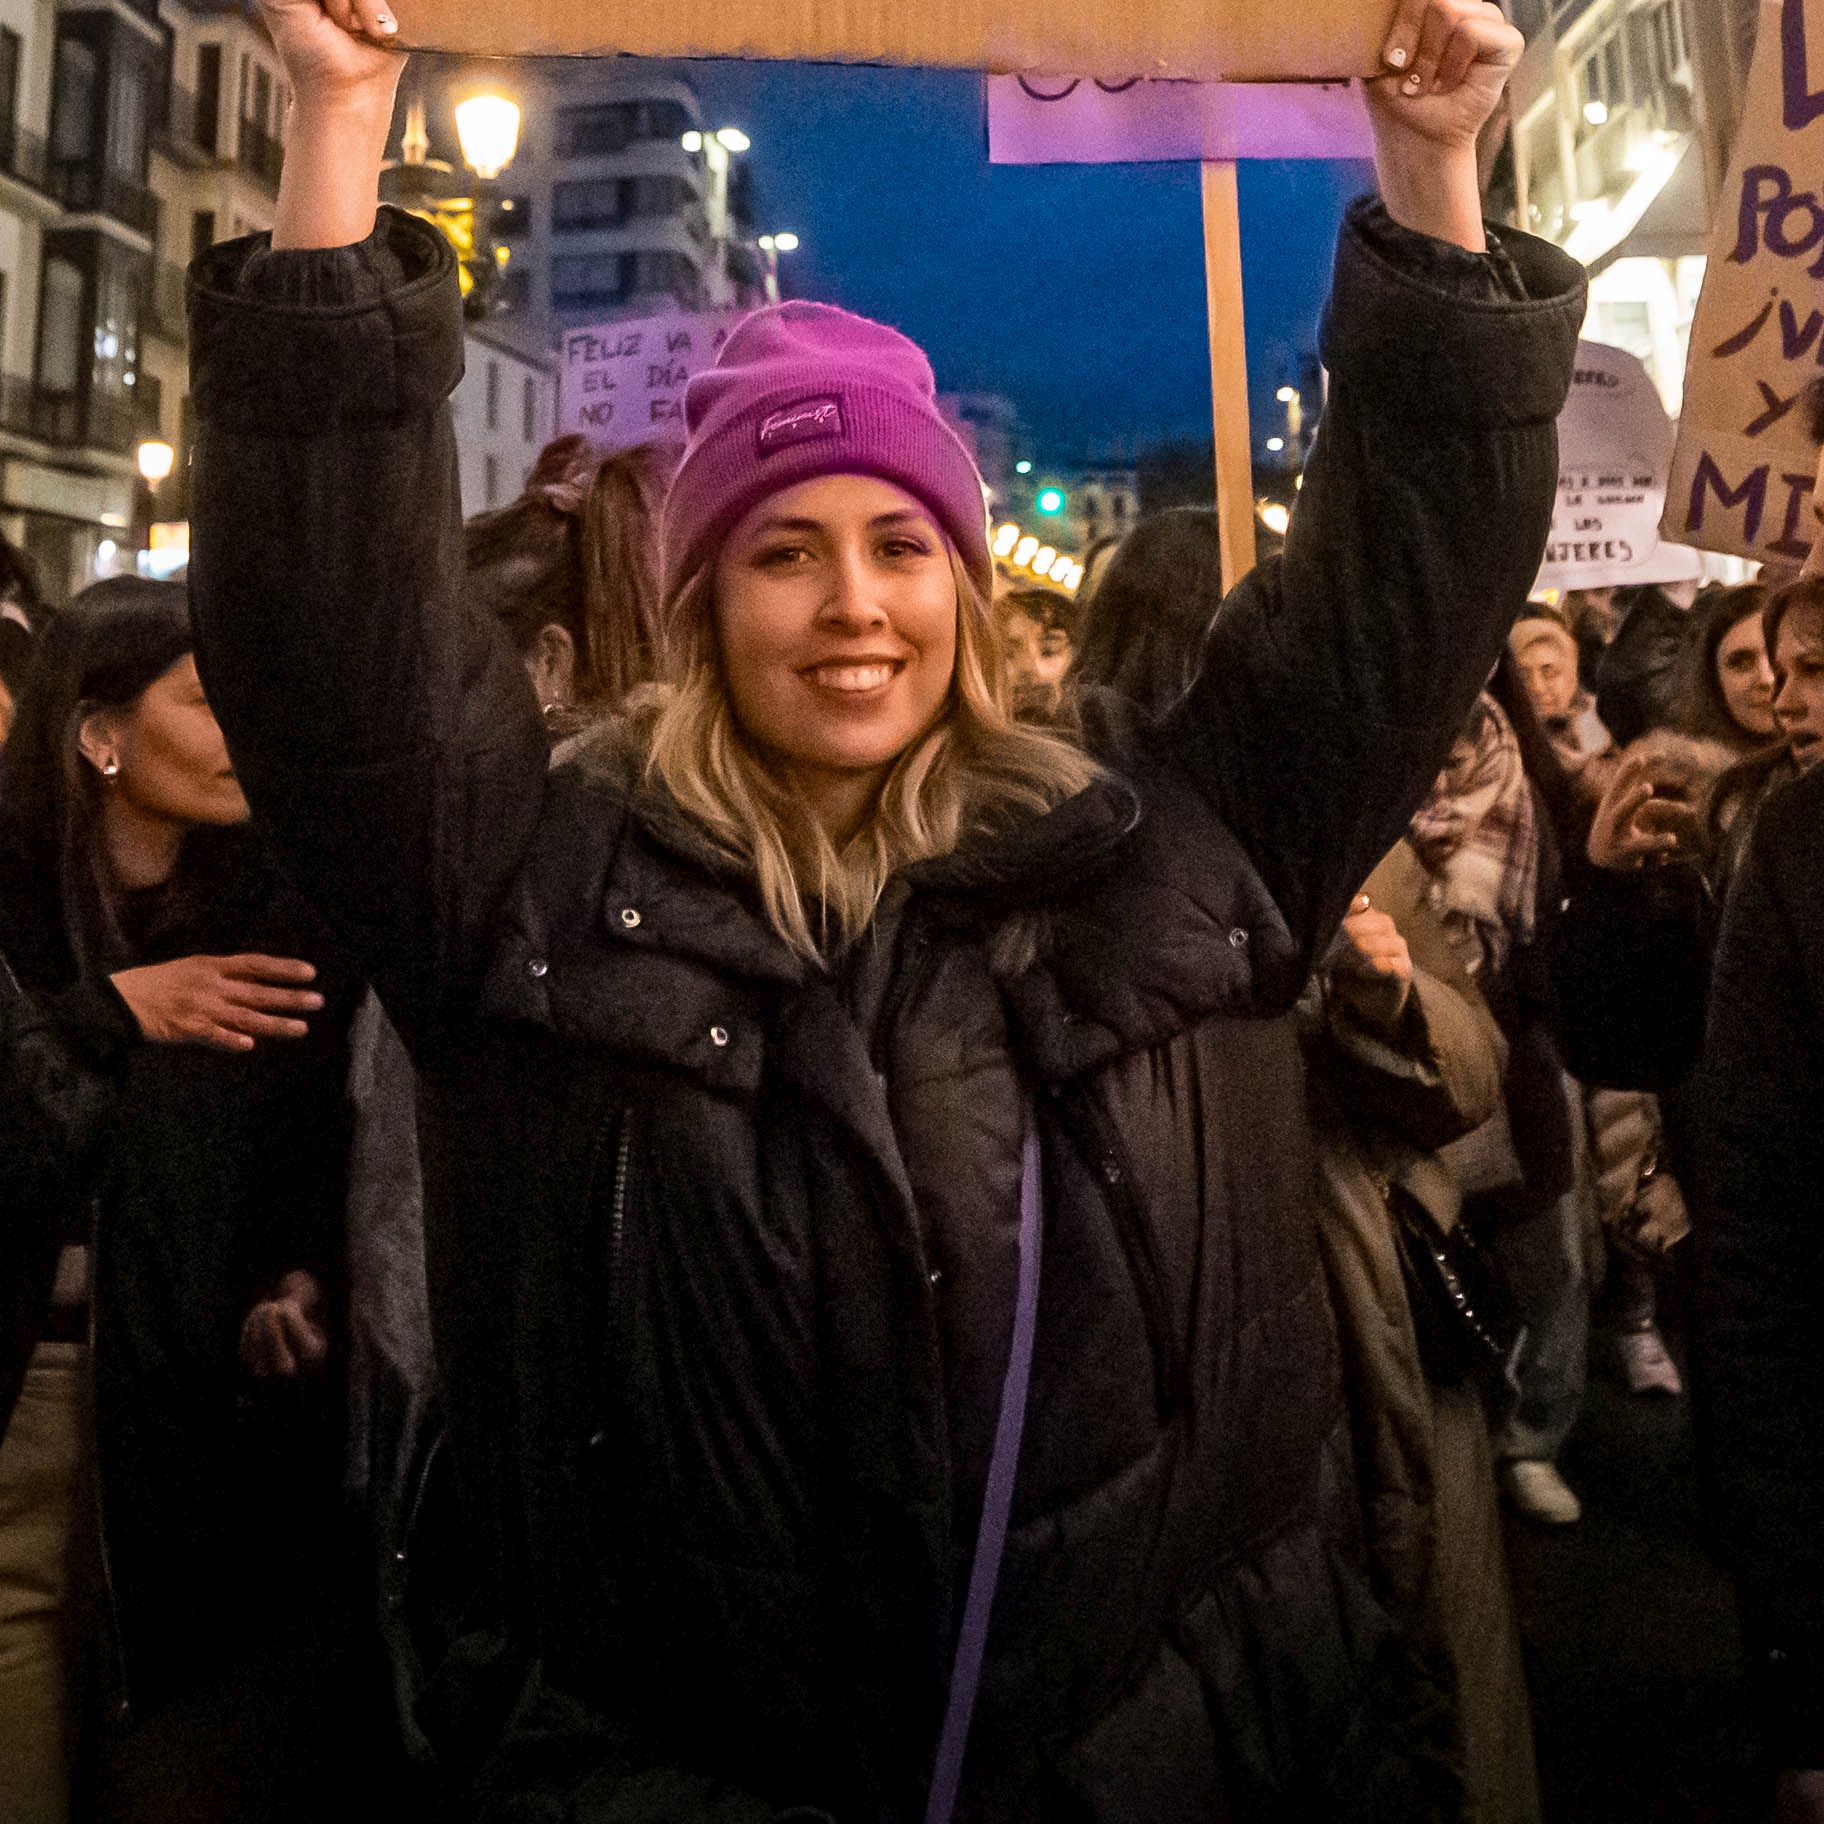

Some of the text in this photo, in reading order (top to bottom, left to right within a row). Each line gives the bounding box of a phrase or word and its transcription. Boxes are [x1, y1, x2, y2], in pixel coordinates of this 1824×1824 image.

[567, 333, 643, 364] FELIZ
[581, 369, 617, 394] EL
[578, 398, 684, 427] NO FA
[1686, 451, 1815, 559] MI
